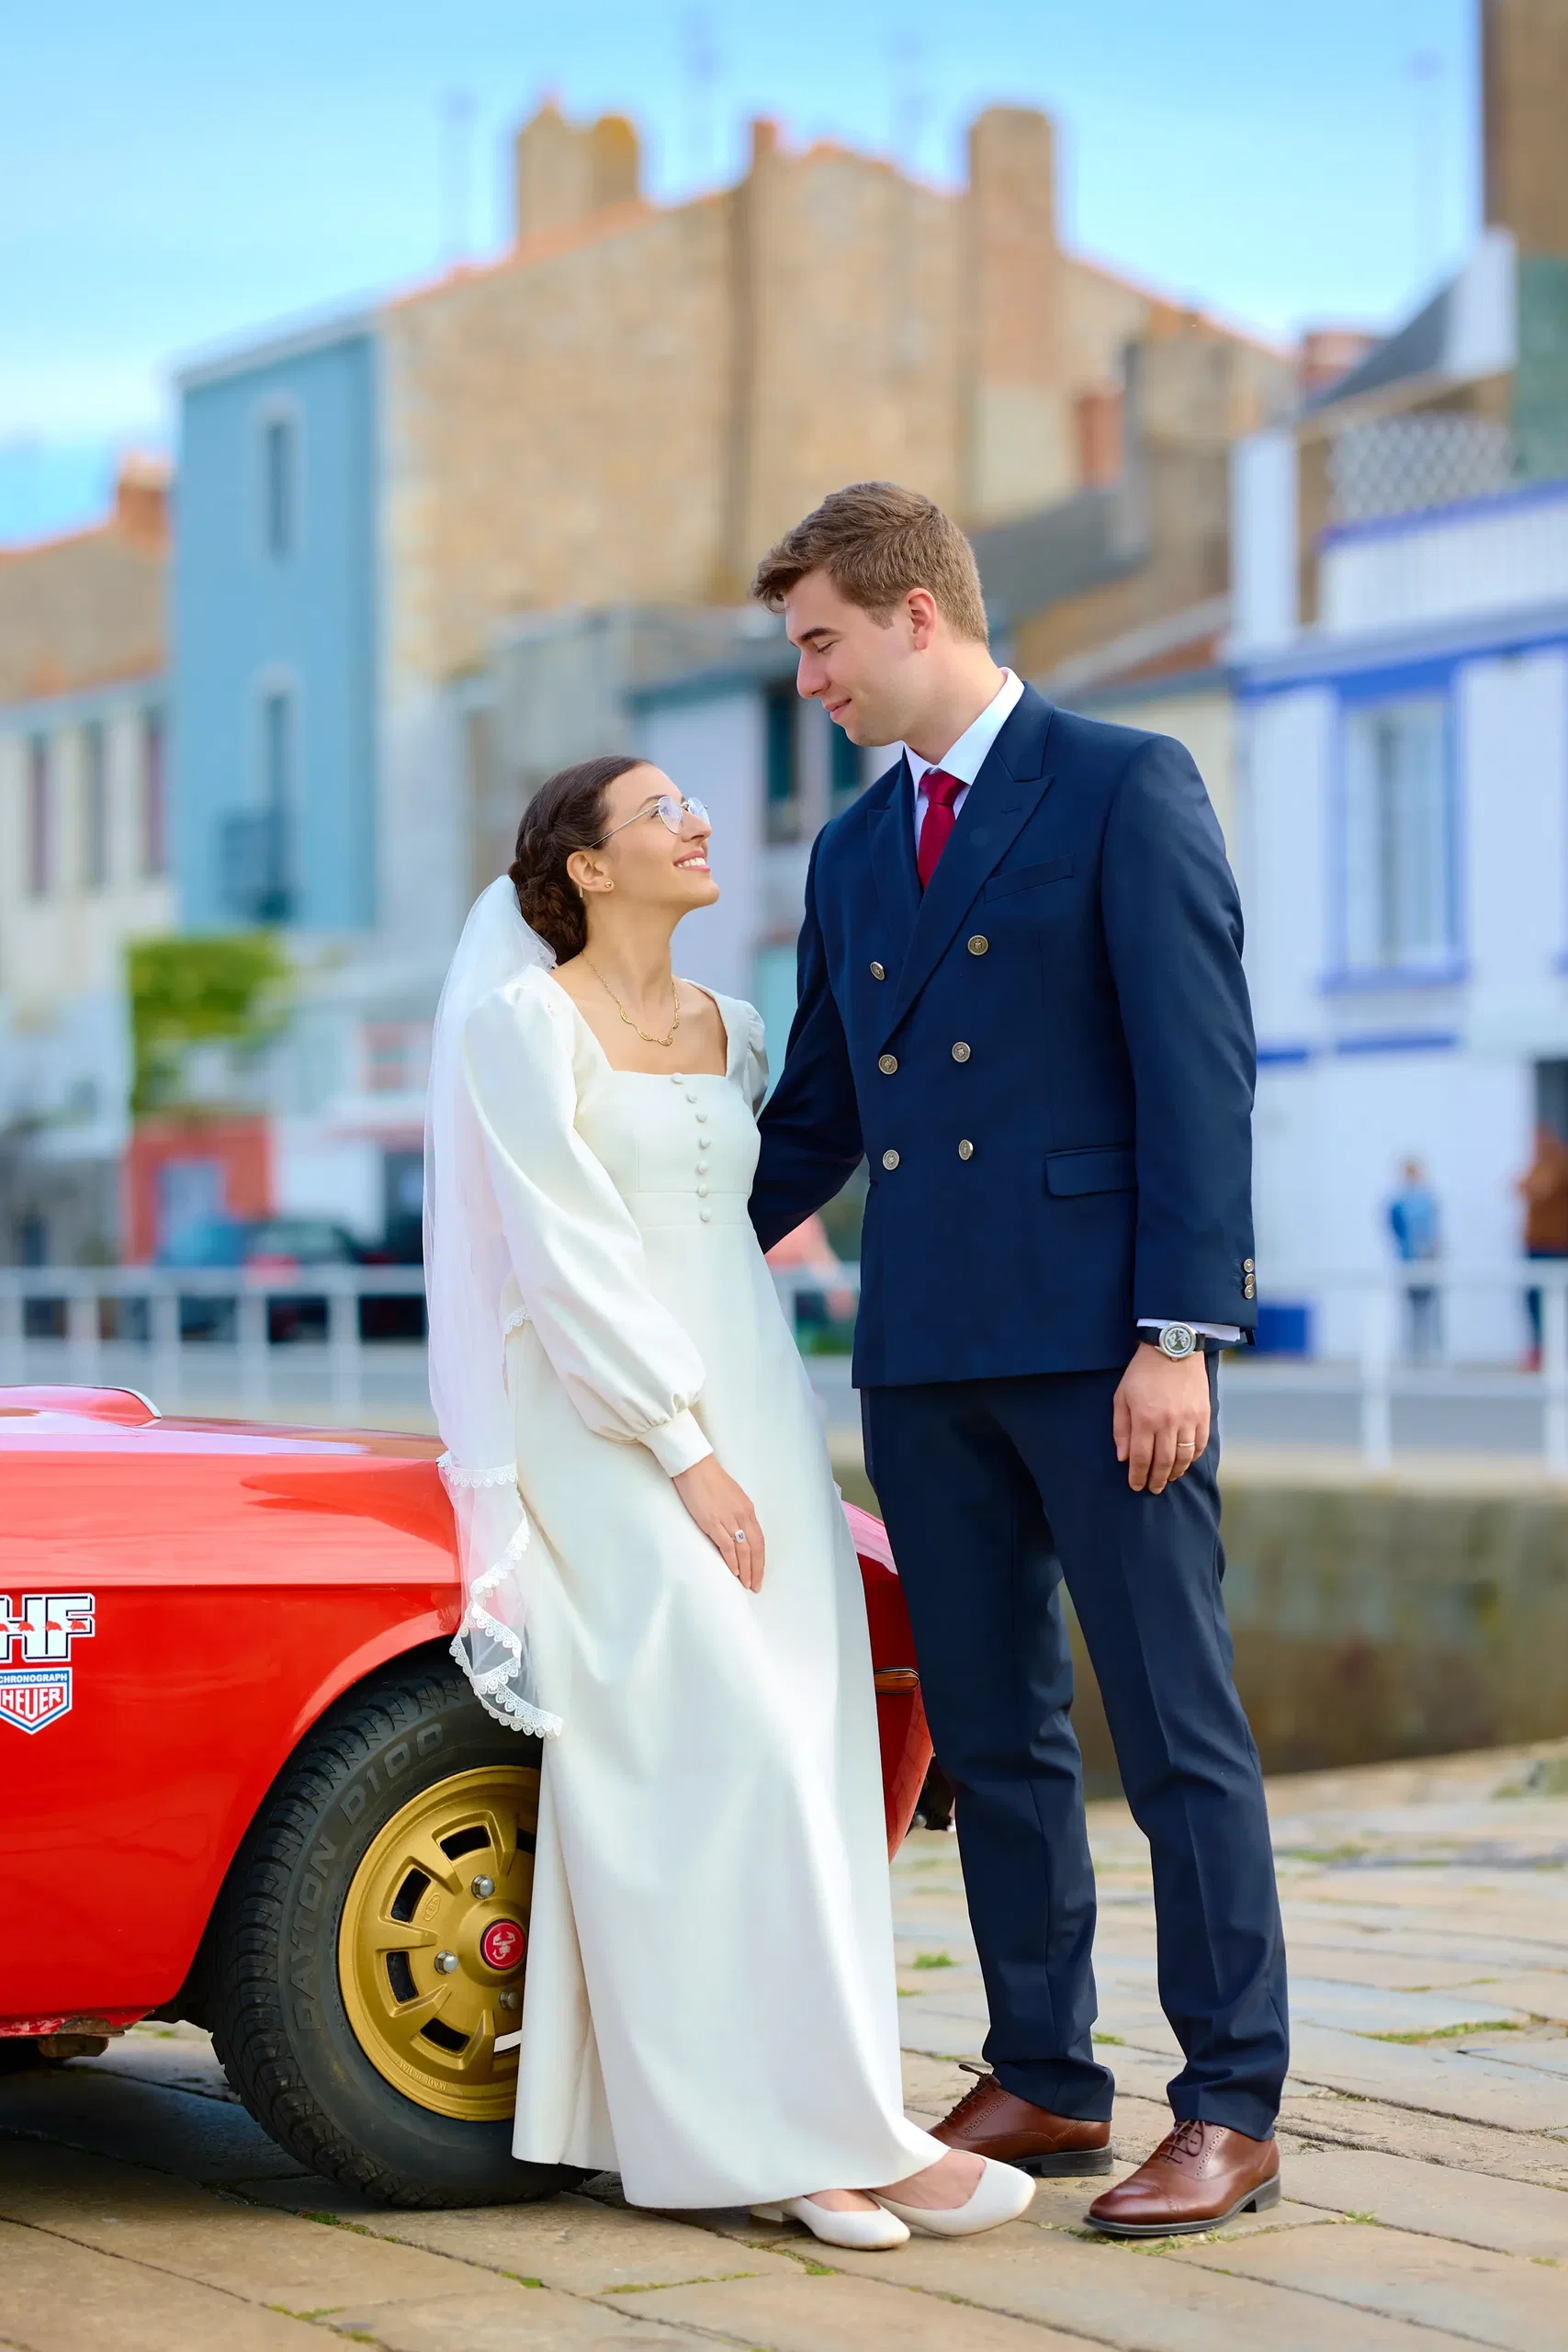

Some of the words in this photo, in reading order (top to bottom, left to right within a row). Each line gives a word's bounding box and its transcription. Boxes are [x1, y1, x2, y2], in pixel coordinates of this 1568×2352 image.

[0, 1593, 96, 1663] HF
[2, 1688, 62, 1720] HEUER
[289, 1834, 338, 2030] DAYTON
